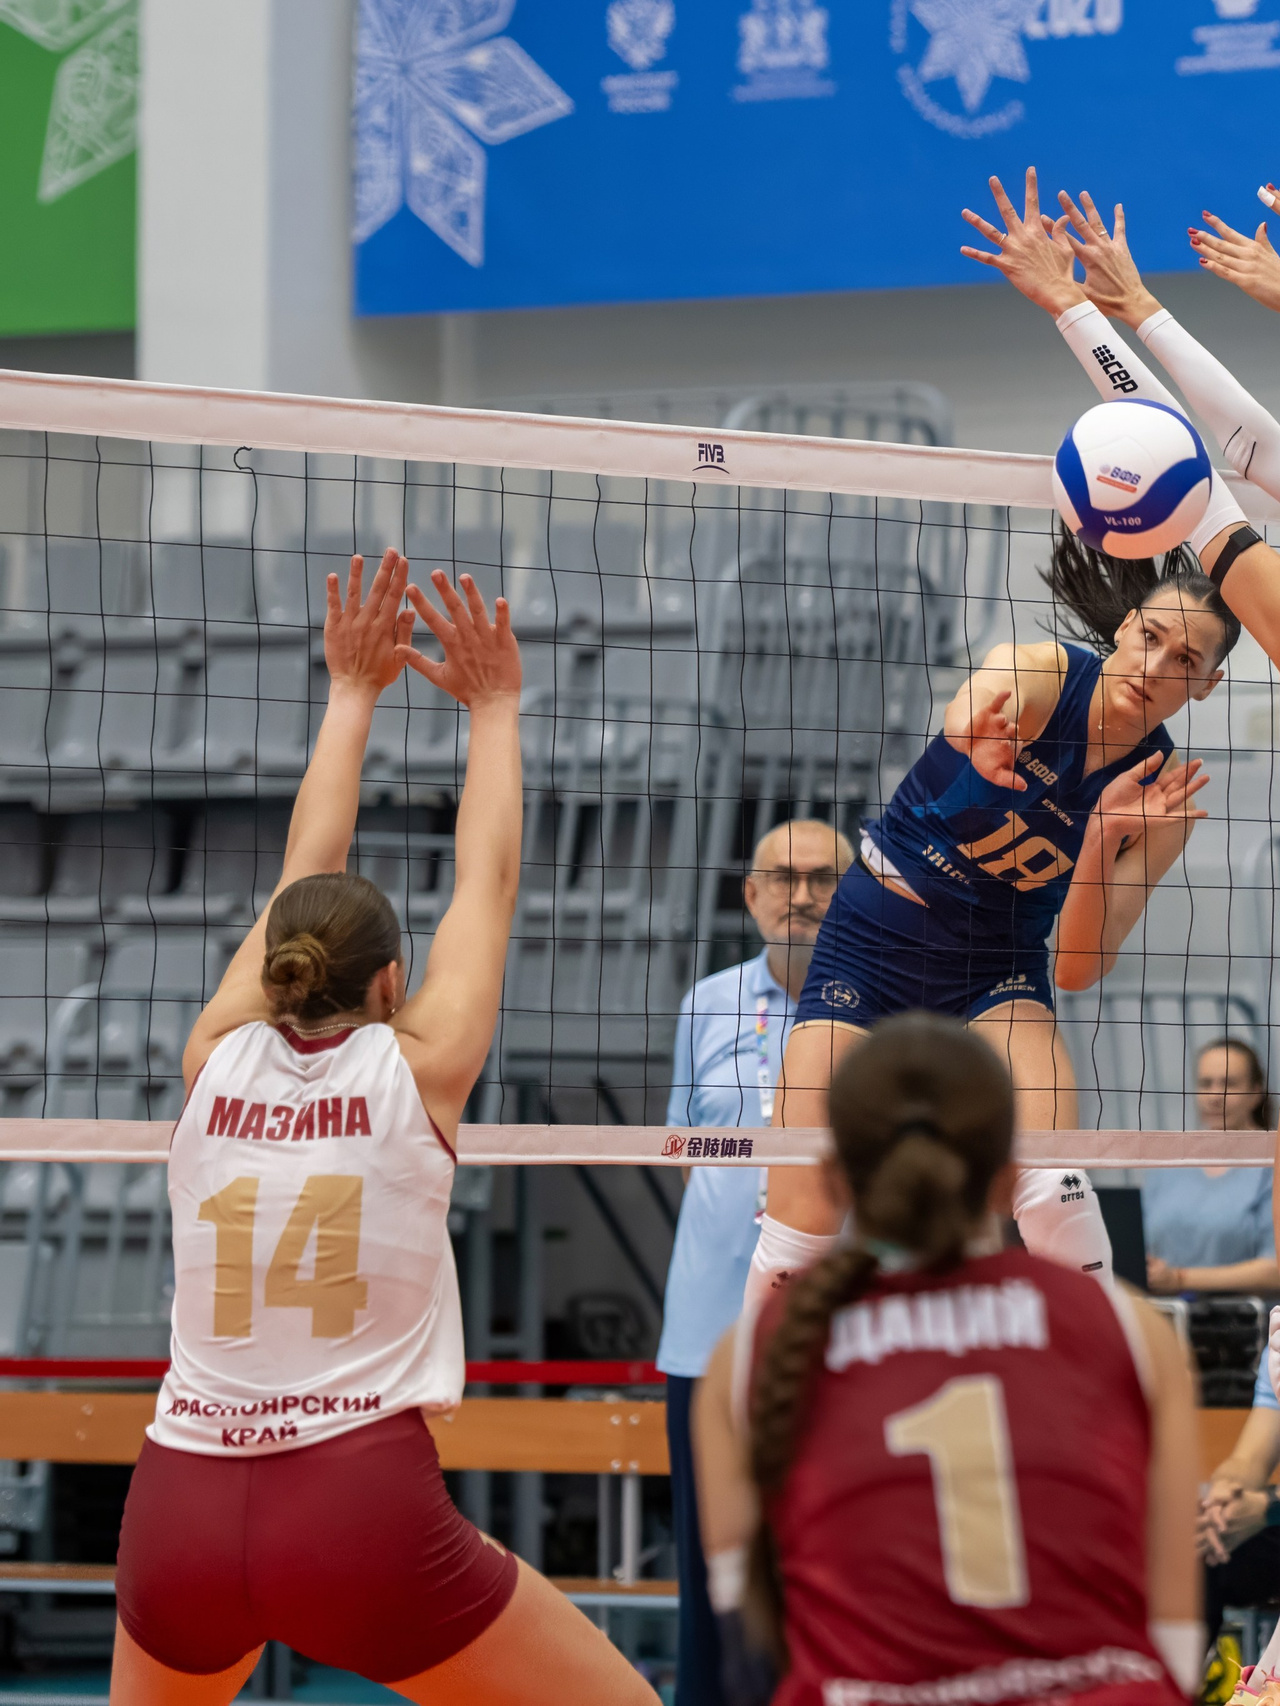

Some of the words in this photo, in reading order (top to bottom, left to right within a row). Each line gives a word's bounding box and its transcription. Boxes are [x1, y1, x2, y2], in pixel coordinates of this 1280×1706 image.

[1101, 361, 1138, 394] cep
[698, 443, 725, 463] FIVB
[1104, 515, 1142, 527] VL-100
[957, 810, 1076, 892] 18
[206, 1096, 373, 1143] МАЗИНА
[687, 1137, 754, 1158] 金陵体育
[197, 1174, 369, 1339] 14
[221, 1420, 298, 1448] КРАЙ
[883, 1373, 1030, 1610] 1
